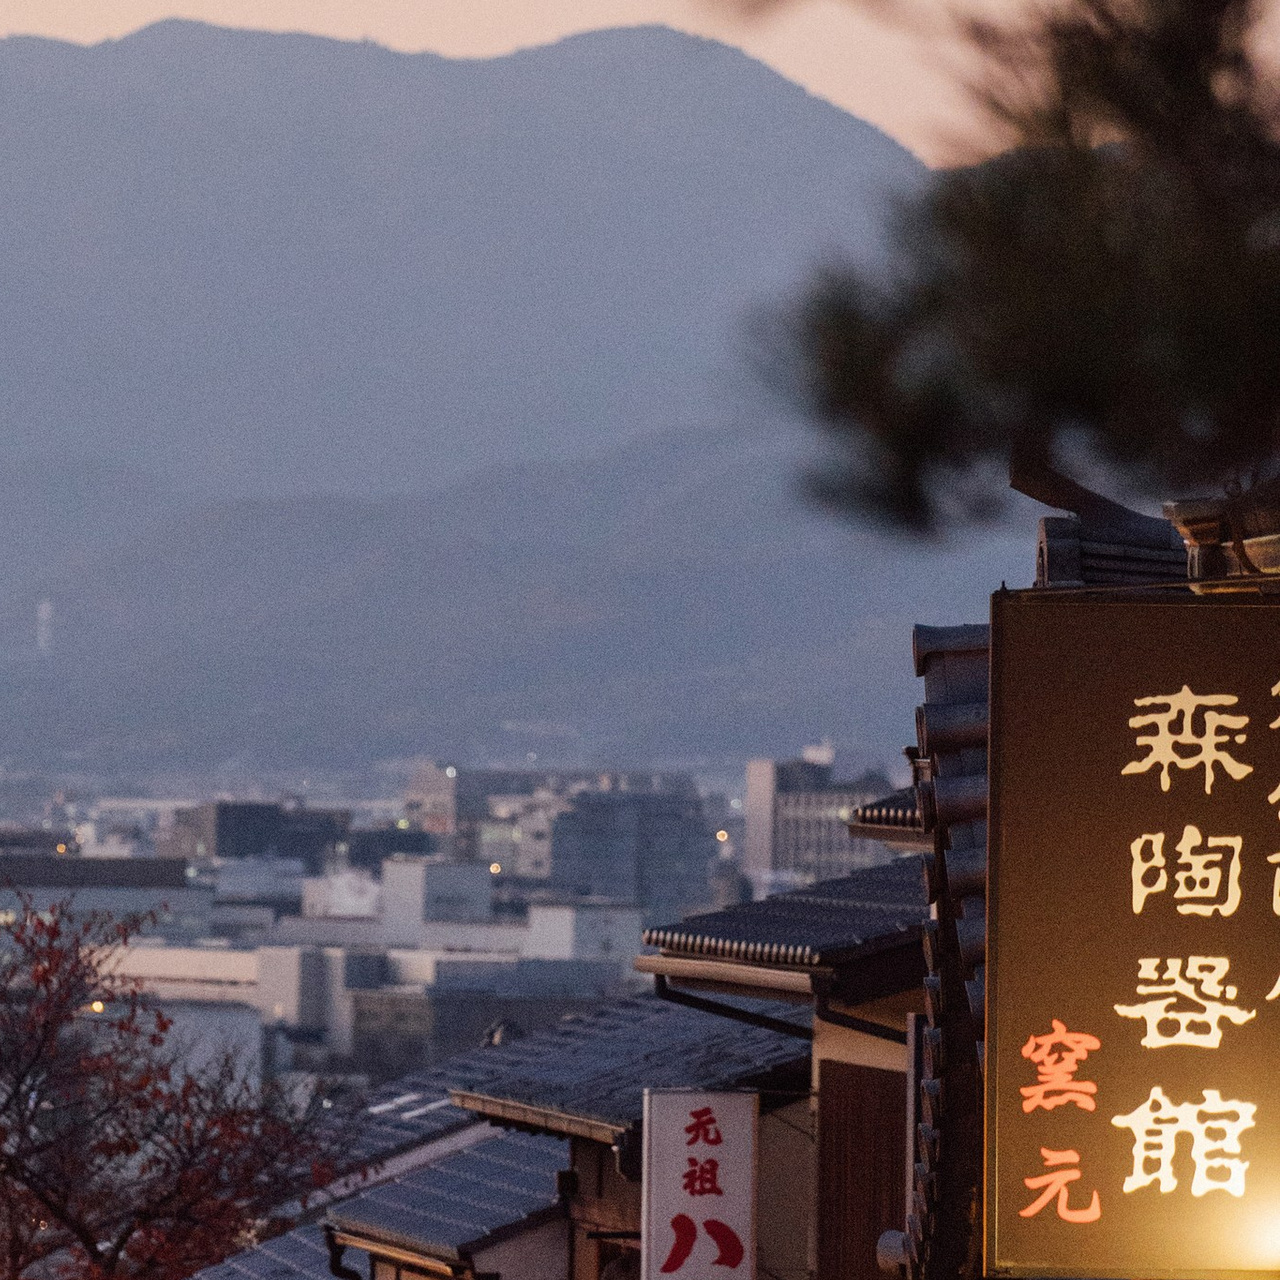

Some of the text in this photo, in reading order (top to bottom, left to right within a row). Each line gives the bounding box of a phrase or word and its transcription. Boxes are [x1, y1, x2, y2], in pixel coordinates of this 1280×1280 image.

[1111, 683, 1258, 1198] 森陶器館
[681, 1106, 724, 1197] 元祖
[1019, 1018, 1102, 1224] 窯元
